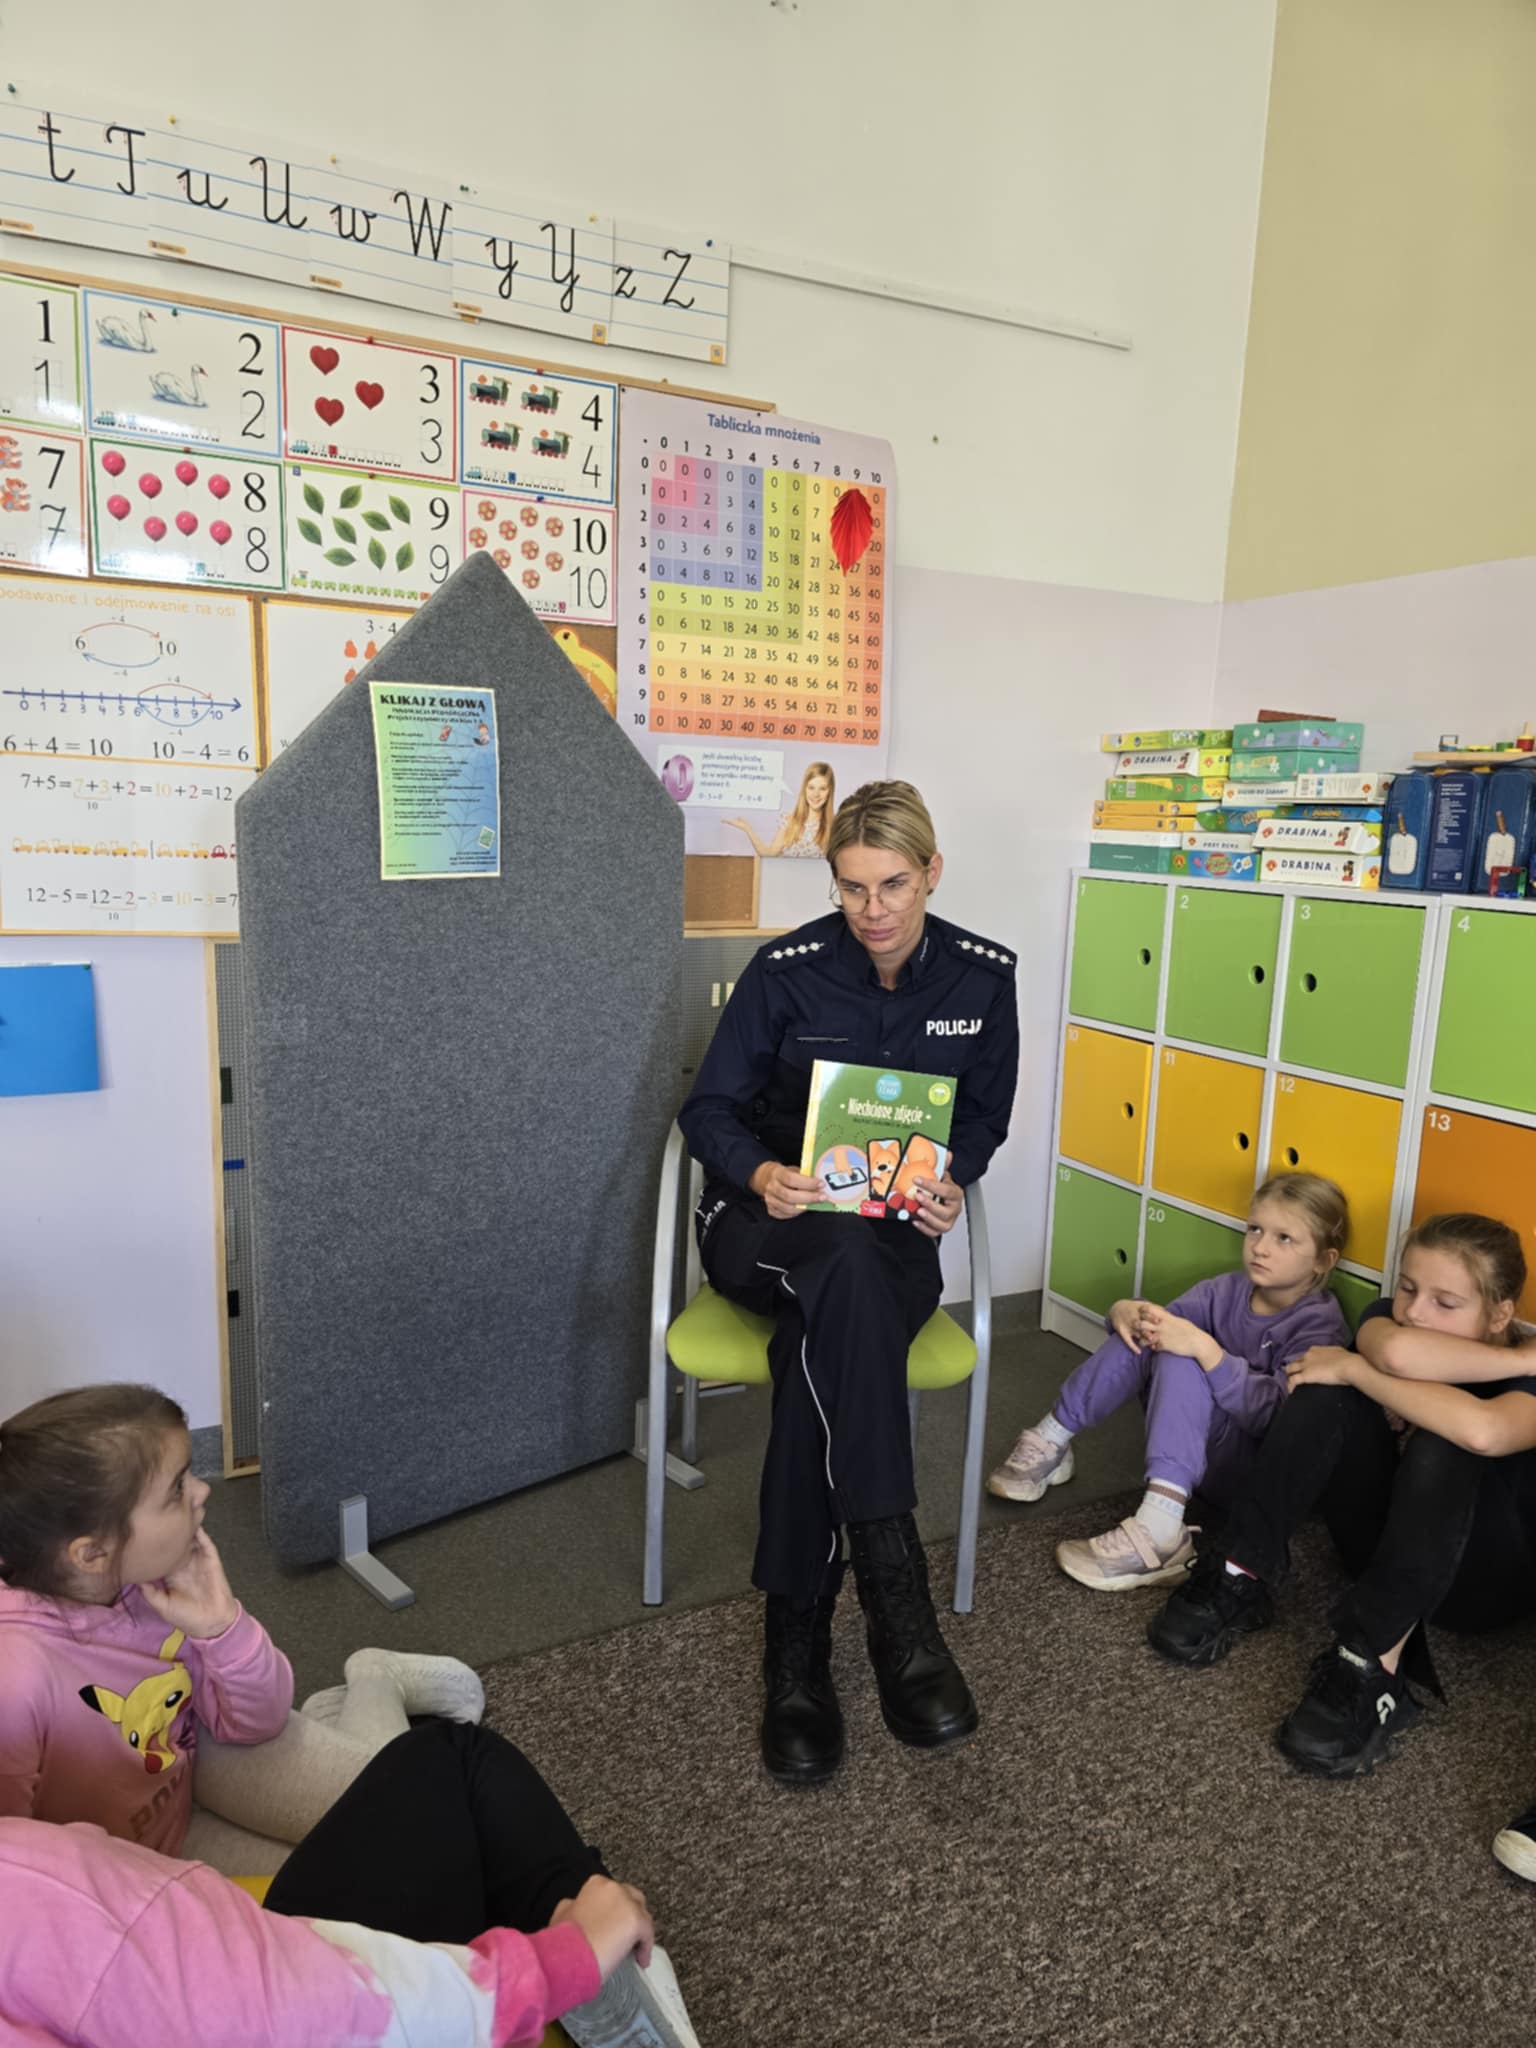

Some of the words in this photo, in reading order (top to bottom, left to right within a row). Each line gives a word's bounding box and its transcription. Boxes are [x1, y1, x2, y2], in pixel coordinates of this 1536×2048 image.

[38, 112, 75, 184] t
[106, 126, 145, 196] T
[177, 168, 228, 210] u
[250, 157, 307, 230] U
[330, 204, 378, 243] w
[394, 191, 452, 262] W
[485, 237, 518, 299] y
[541, 223, 580, 313] Y
[614, 267, 636, 299] z
[662, 249, 694, 309] Z
[37, 300, 55, 344] 1
[239, 333, 263, 375] 2
[35, 360, 48, 405] 1
[420, 365, 439, 403] 3
[242, 390, 264, 439] 2
[582, 395, 603, 431] 4
[421, 419, 442, 464] 3
[707, 413, 762, 436] Tabliczka
[765, 426, 822, 446] mnożenia
[39, 447, 65, 489] 7
[582, 446, 601, 488] 4
[661, 437, 667, 448] 0
[685, 440, 688, 452] 1
[706, 445, 711, 456] 2
[728, 449, 733, 459] 3
[749, 453, 756, 462] 4
[773, 455, 778, 466] 5
[793, 459, 799, 469] 6
[814, 461, 820, 472] 7
[834, 465, 840, 476] 8
[854, 469, 860, 479] 9
[871, 472, 881, 483] 10
[244, 473, 266, 512] 8
[40, 504, 66, 553] 7
[430, 498, 449, 530] 9
[574, 518, 606, 554] 10
[641, 510, 646, 521] 2
[658, 513, 665, 524] 0
[682, 516, 687, 528] 2
[704, 520, 710, 529] 4
[727, 522, 733, 532] 6
[749, 524, 755, 535] 8
[769, 526, 780, 538] 10
[791, 529, 800, 541] 12
[812, 532, 820, 542] 14
[868, 540, 881, 552] 20
[246, 527, 269, 573] 8
[430, 545, 452, 586] 9
[570, 566, 607, 608] 10
[639, 563, 646, 573] 4
[657, 564, 665, 576] 0
[680, 568, 687, 577] 4
[703, 569, 710, 580] 8
[724, 571, 734, 583] 12
[746, 574, 756, 585] 16
[767, 576, 780, 588] 20
[789, 579, 799, 589] 24
[809, 581, 820, 593] 28
[830, 584, 839, 595] 32
[850, 586, 860, 597] 36
[868, 589, 880, 599] 40
[95, 594, 188, 613] odejmowanie
[196, 603, 211, 615] na
[217, 603, 235, 616] osi
[367, 620, 374, 633] 3
[388, 622, 397, 635] 4
[639, 614, 645, 624] 6
[657, 616, 664, 626] 0
[680, 618, 687, 628] 6
[701, 619, 711, 631] 12
[724, 622, 734, 632] 18
[745, 623, 757, 634] 24
[767, 625, 779, 637] 30
[788, 628, 799, 639] 36
[807, 631, 818, 641] 42
[827, 633, 839, 643] 48
[848, 634, 859, 644] 54
[867, 636, 879, 647] 60
[76, 637, 85, 649] 6
[159, 641, 176, 654] 10
[639, 664, 645, 674] 8
[657, 665, 664, 676] 0
[680, 667, 687, 678] 8
[701, 669, 711, 680] 16
[723, 671, 734, 681] 24
[745, 672, 756, 684] 32
[765, 675, 777, 685] 40
[785, 677, 798, 687] 48
[807, 678, 818, 688] 56
[826, 680, 838, 690] 64
[848, 681, 857, 692] 72
[865, 683, 878, 694] 80
[20, 700, 29, 711] 0
[40, 701, 46, 711] 1
[60, 702, 67, 713] 2
[80, 703, 86, 713] 3
[99, 704, 106, 715] 4
[118, 705, 125, 716] 5
[134, 705, 141, 716] 6
[156, 707, 162, 717] 7
[173, 707, 179, 718] 8
[192, 708, 198, 718] 9
[209, 710, 223, 720] 10
[380, 694, 426, 707] KLIKAJ
[429, 696, 437, 707] Z
[634, 714, 645, 725] 10
[657, 715, 664, 727] 0
[678, 717, 688, 728] 10
[699, 718, 711, 729] 20
[721, 720, 732, 731] 30
[741, 722, 754, 732] 40
[763, 722, 775, 733] 50
[783, 724, 796, 734] 60
[805, 725, 816, 736] 70
[824, 727, 837, 738] 80
[845, 728, 856, 738] 90
[863, 729, 878, 740] 100
[4, 735, 16, 752] 6
[45, 737, 59, 754] 4
[89, 738, 112, 756] 10
[152, 742, 175, 759] 10
[199, 744, 212, 761] 4
[238, 745, 249, 762] 6
[1134, 755, 1172, 764] DRABINA
[87, 802, 98, 810] 10
[1277, 827, 1326, 837] DRABINA
[1281, 860, 1331, 871] DRABINA
[108, 912, 119, 920] 10
[1180, 895, 1189, 909] 2
[1301, 905, 1310, 919] 3
[1458, 916, 1470, 932] 4
[1165, 1051, 1175, 1065] 11
[1280, 1077, 1295, 1093] 12
[1429, 1112, 1450, 1131] 13
[1059, 1169, 1071, 1181] 19
[1148, 1207, 1165, 1222] 20
